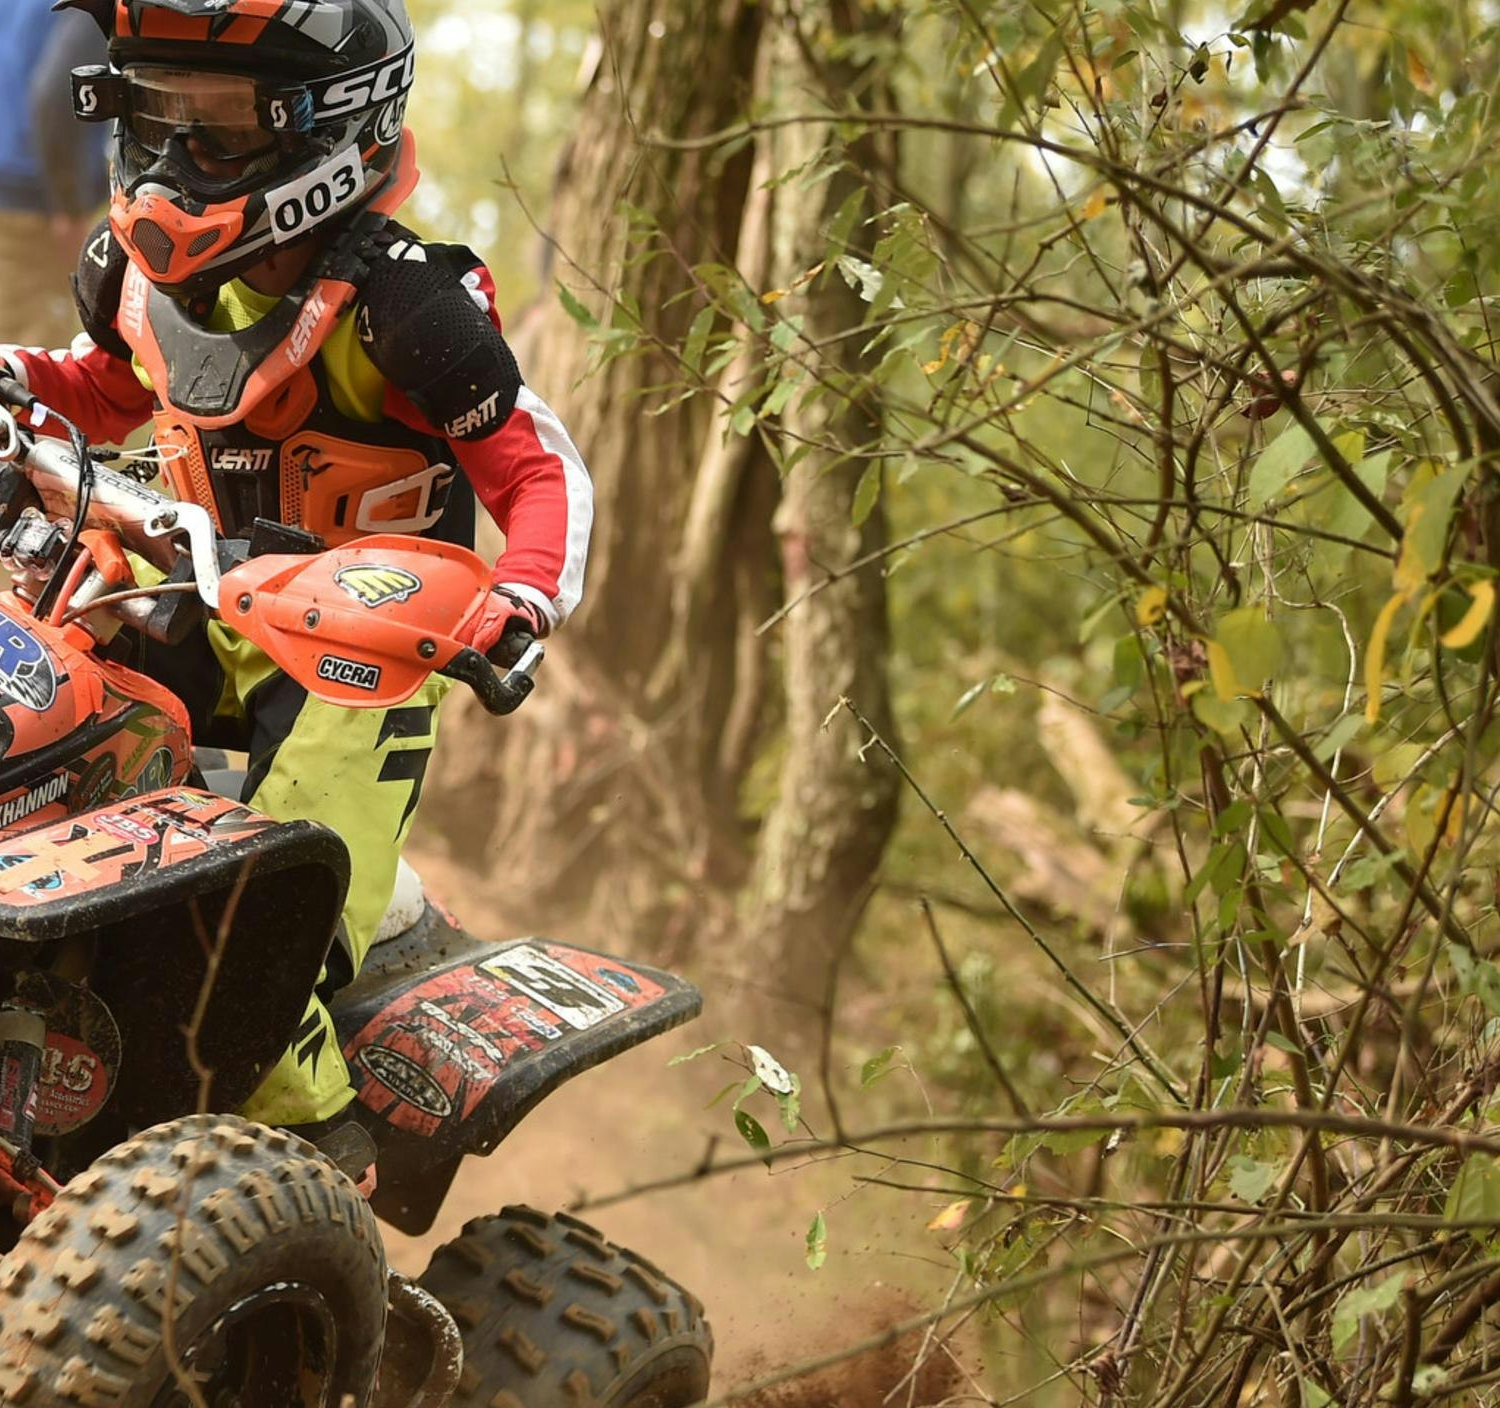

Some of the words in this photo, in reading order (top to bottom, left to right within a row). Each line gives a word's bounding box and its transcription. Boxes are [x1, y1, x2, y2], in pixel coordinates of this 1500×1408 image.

[275, 163, 357, 235] 003
[443, 392, 499, 439] LEATT
[210, 447, 273, 471] LEATT
[319, 658, 379, 688] CYCRA
